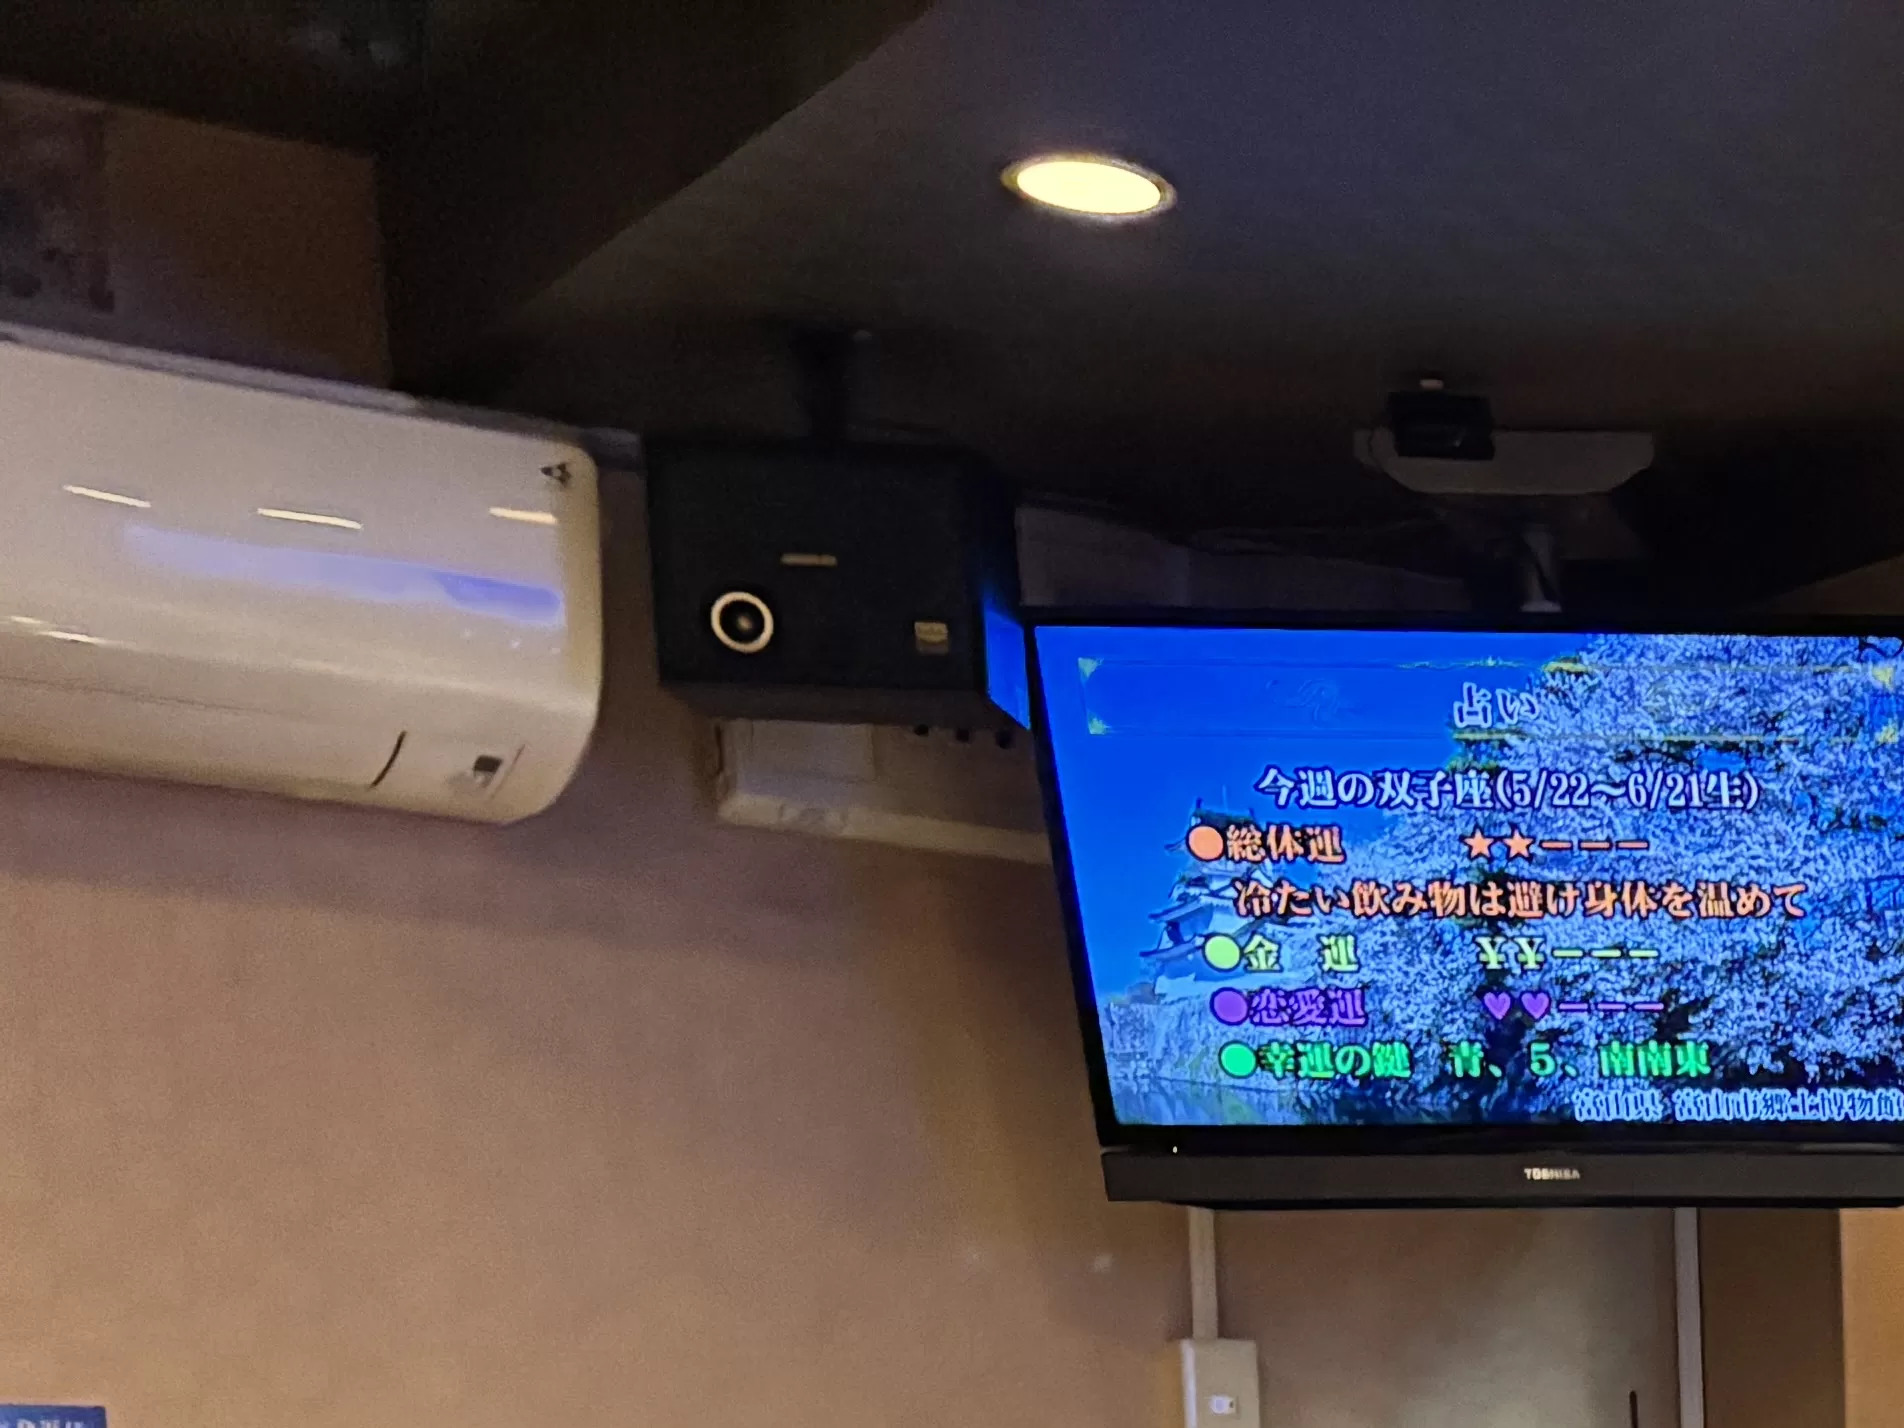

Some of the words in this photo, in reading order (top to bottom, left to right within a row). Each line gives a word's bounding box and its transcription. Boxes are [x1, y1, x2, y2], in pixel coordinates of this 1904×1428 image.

[1453, 682, 1539, 728] 占い
[1234, 880, 1808, 918] 冷たい飲み物は避け身体を温めて
[1252, 988, 1367, 1025] 恋愛運
[1258, 1041, 1411, 1079] 幸運の鍵
